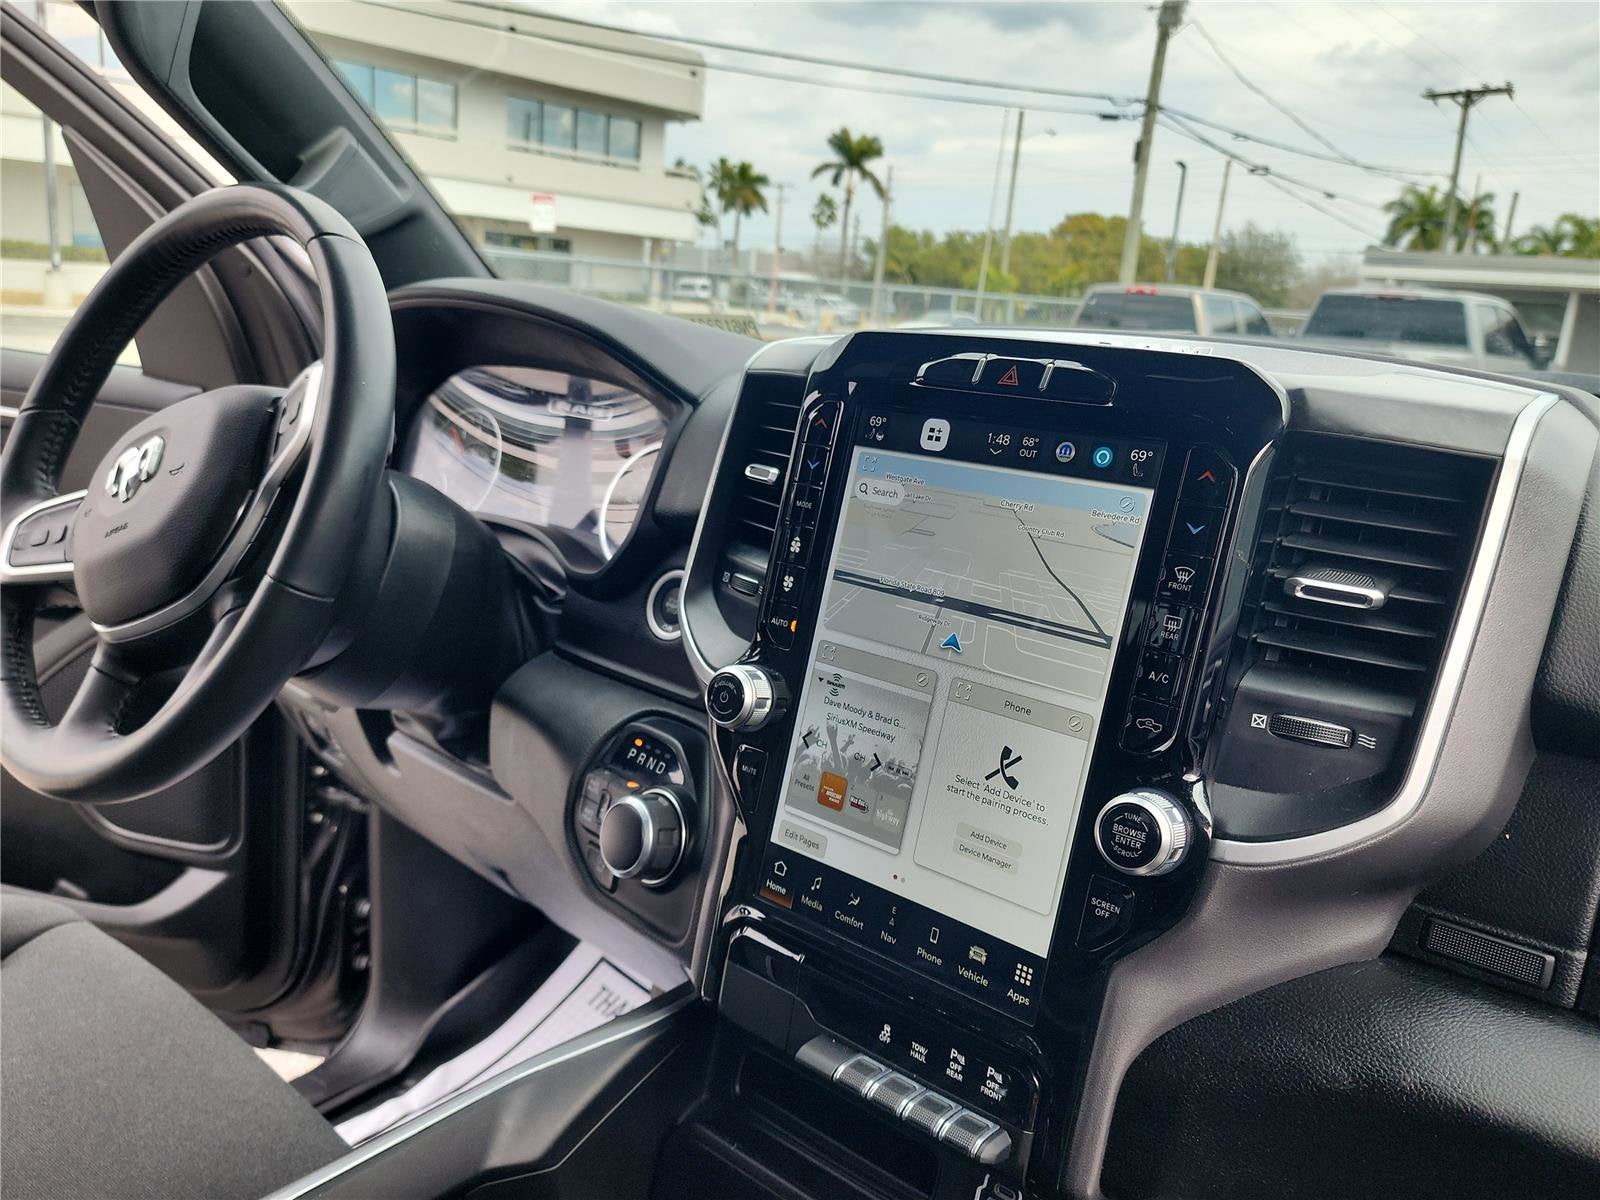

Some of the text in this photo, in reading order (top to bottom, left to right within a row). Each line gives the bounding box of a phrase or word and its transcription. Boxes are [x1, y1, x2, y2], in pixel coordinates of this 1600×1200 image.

[869, 416, 887, 427] 69°
[986, 432, 1011, 446] 1:48
[1022, 436, 1039, 447] 68°
[1019, 449, 1038, 458] OUT
[1130, 449, 1153, 462] 69°
[872, 486, 899, 498] Search
[1000, 499, 1034, 512] Cherry Rd
[1092, 509, 1141, 524] Belvedere Rd
[1017, 524, 1065, 538] Country Club Rd
[917, 585, 932, 594] Road
[1168, 581, 1193, 592] FRONT
[771, 617, 788, 627] AUTO
[1160, 630, 1179, 641] REAR
[1148, 671, 1170, 684] A/C
[823, 696, 842, 709] Dave
[842, 702, 867, 718] Moody
[867, 710, 874, 719] &
[874, 712, 893, 726] Brad
[1003, 700, 1032, 716] Phone
[826, 712, 896, 743] SiriusXM Speedway
[816, 739, 827, 749] CH
[742, 765, 757, 776] MUTE
[795, 780, 815, 792] Presets
[955, 774, 980, 790] Select
[1036, 801, 1046, 812] to
[946, 784, 1049, 826] start the pairing process.
[1124, 812, 1142, 824] TUNE
[1112, 823, 1147, 840] BROWSE
[784, 828, 820, 850] Edit Pages
[970, 830, 1008, 850] Add Device
[1115, 834, 1142, 850] ENTER
[959, 844, 1012, 870] Device Manager
[1113, 845, 1139, 858] SCROLL
[765, 878, 787, 896] Home
[801, 894, 823, 911] Media
[1091, 897, 1121, 914] SCREEN
[834, 910, 864, 930] Comfort
[1094, 908, 1111, 919] OFF
[880, 930, 897, 945] Nav
[916, 946, 943, 966] Phone
[958, 965, 989, 987] Vehicle
[1006, 988, 1030, 1006] Apps
[909, 1049, 927, 1064] HAUL
[949, 1061, 963, 1072] OFF
[945, 1068, 963, 1082] REAR
[986, 1079, 1000, 1092] OFF
[980, 1085, 1003, 1102] FRONT
